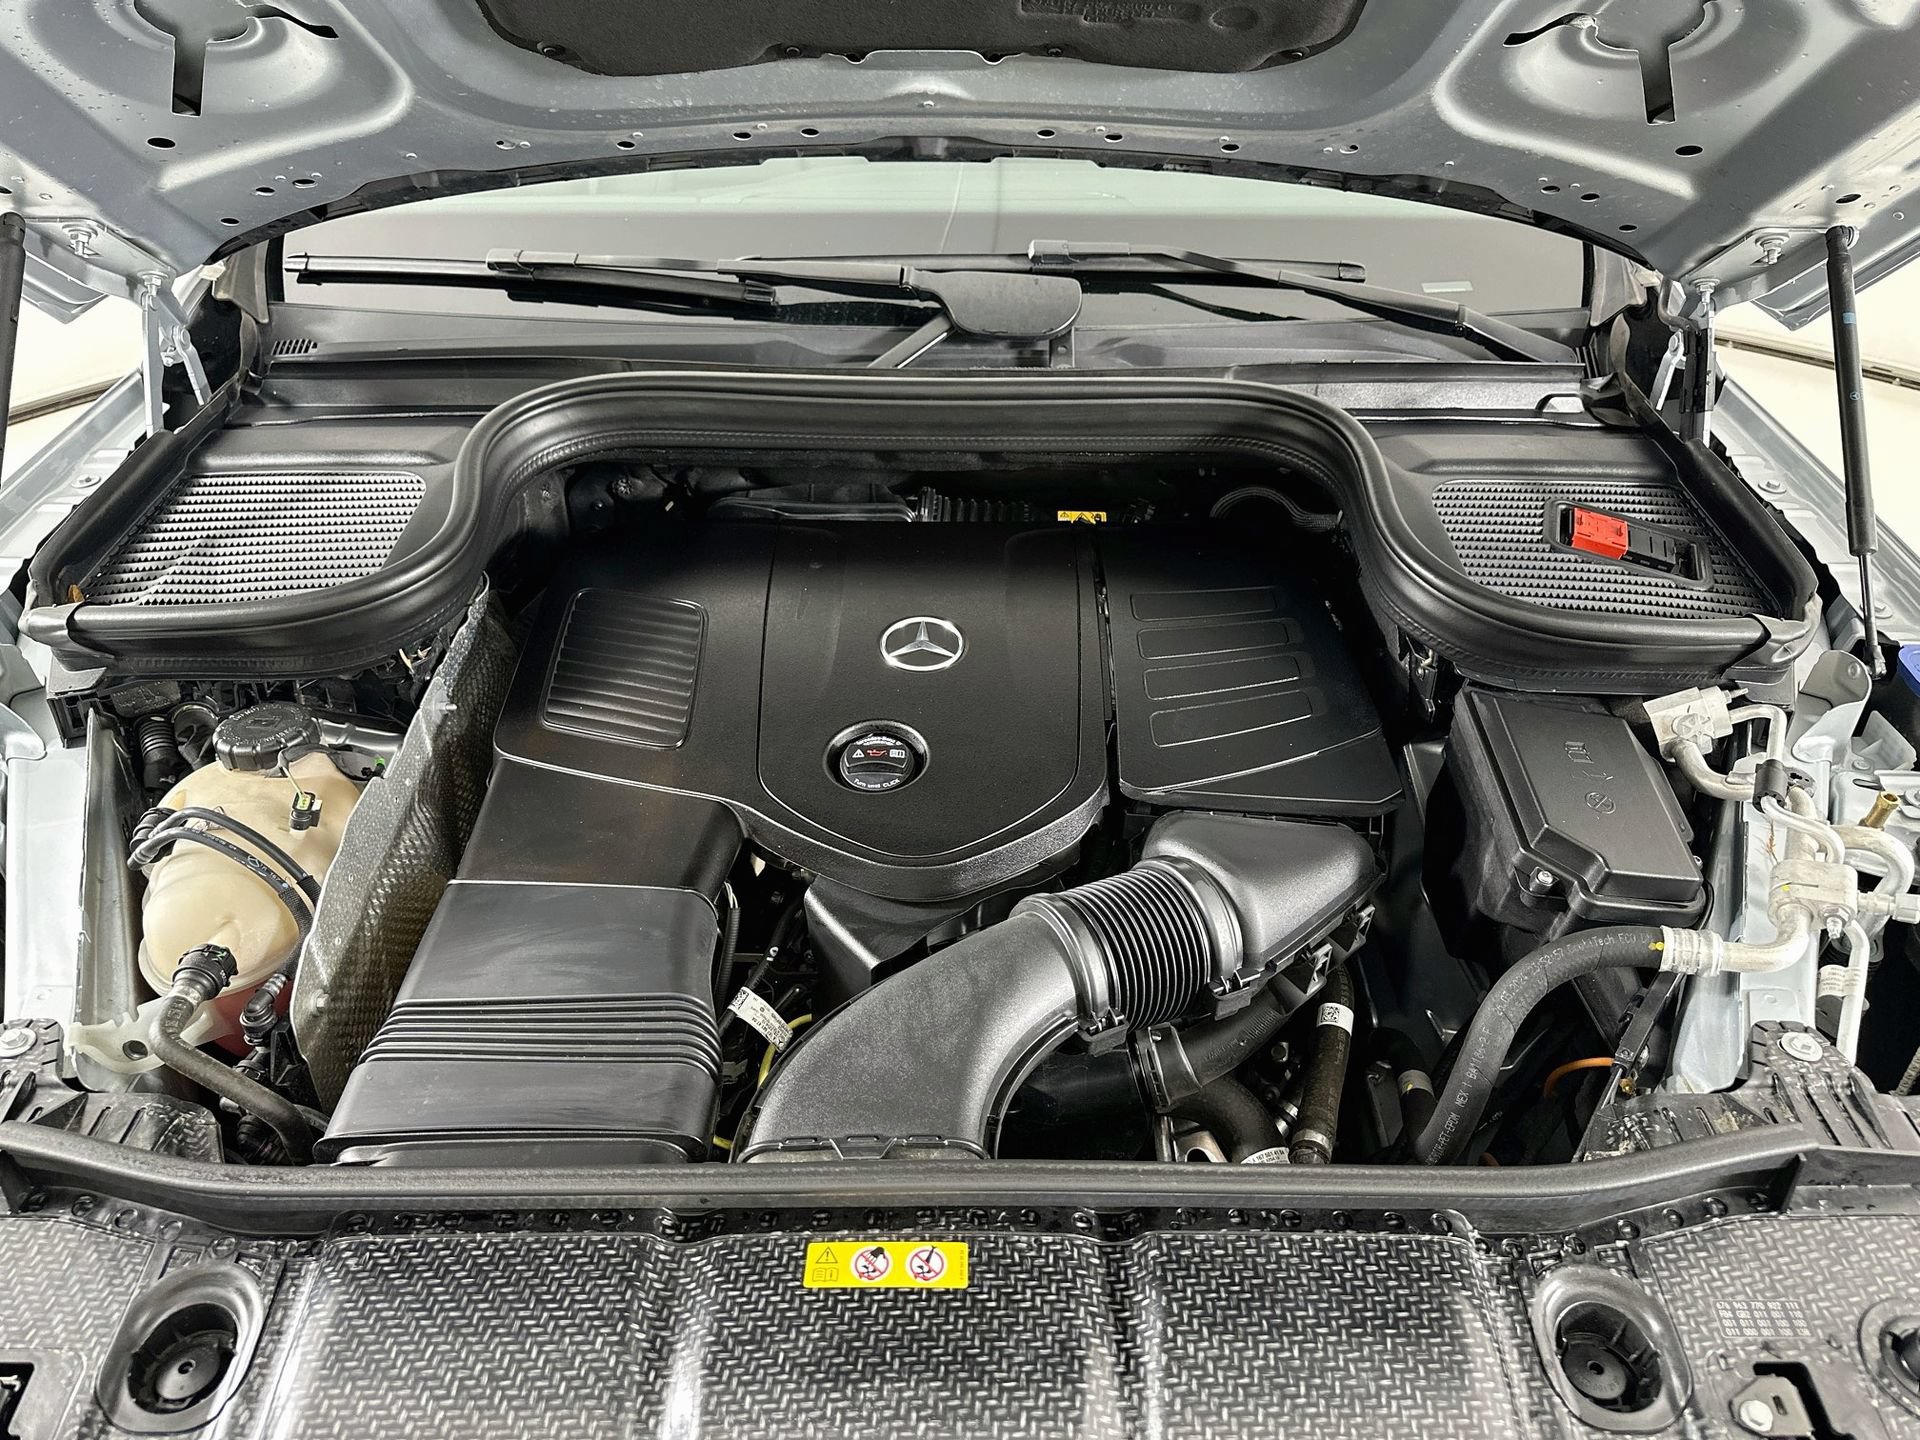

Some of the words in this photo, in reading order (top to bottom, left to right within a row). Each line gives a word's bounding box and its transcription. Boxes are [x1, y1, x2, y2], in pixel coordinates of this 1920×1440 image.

[854, 778, 866, 788] Turn
[882, 778, 900, 788] CLICK
[1725, 1328, 1740, 1336] 011
